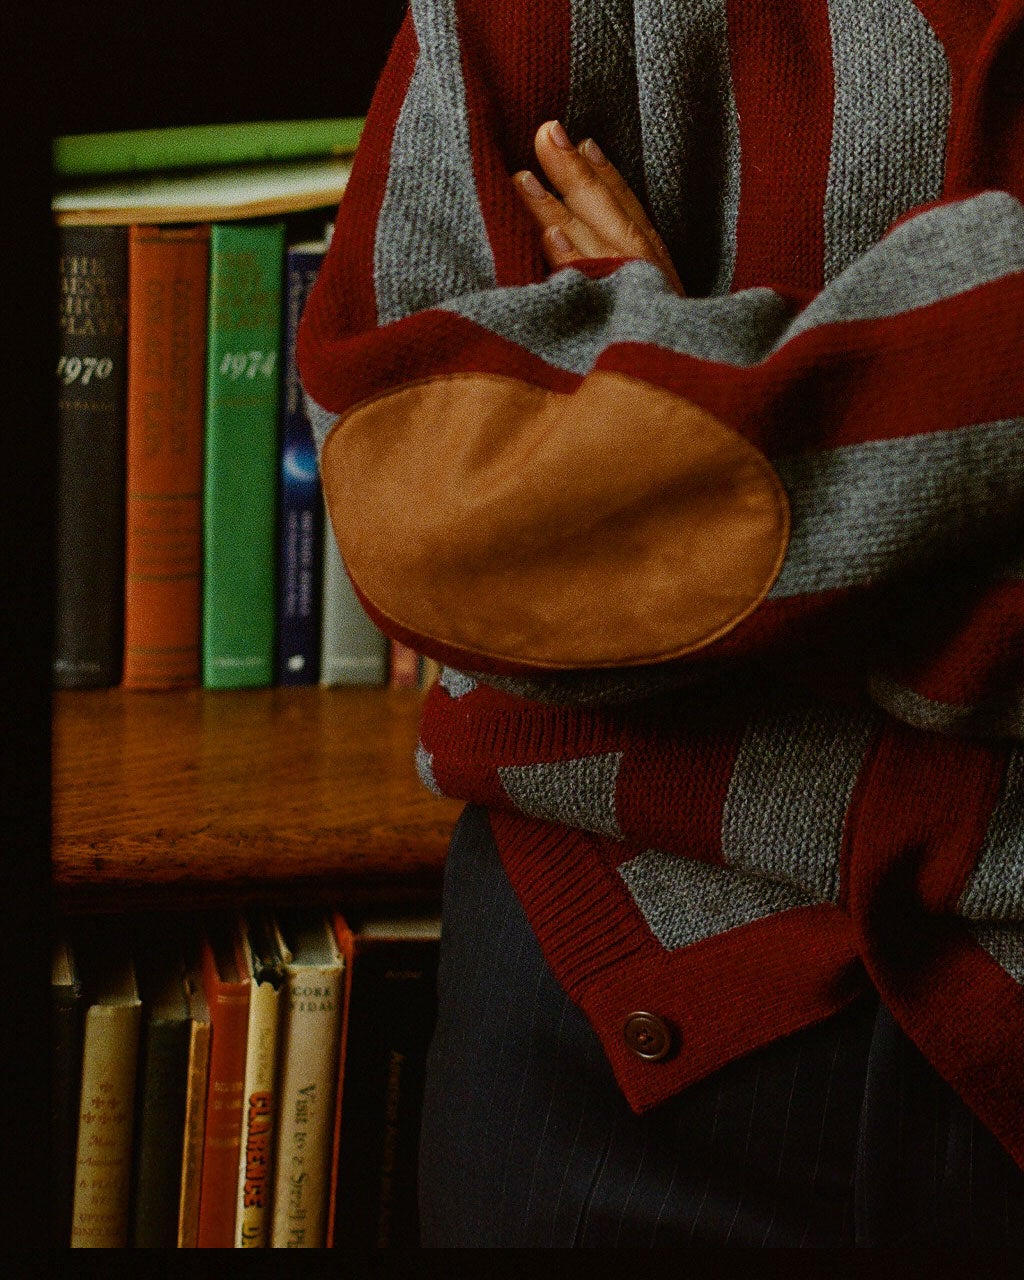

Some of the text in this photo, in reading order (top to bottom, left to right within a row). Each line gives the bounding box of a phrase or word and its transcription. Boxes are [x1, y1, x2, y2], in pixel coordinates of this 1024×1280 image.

[56, 354, 114, 387] 1970
[295, 1083, 317, 1125] Visit
[244, 1091, 273, 1209] CLARENCE
[293, 1131, 308, 1150] to
